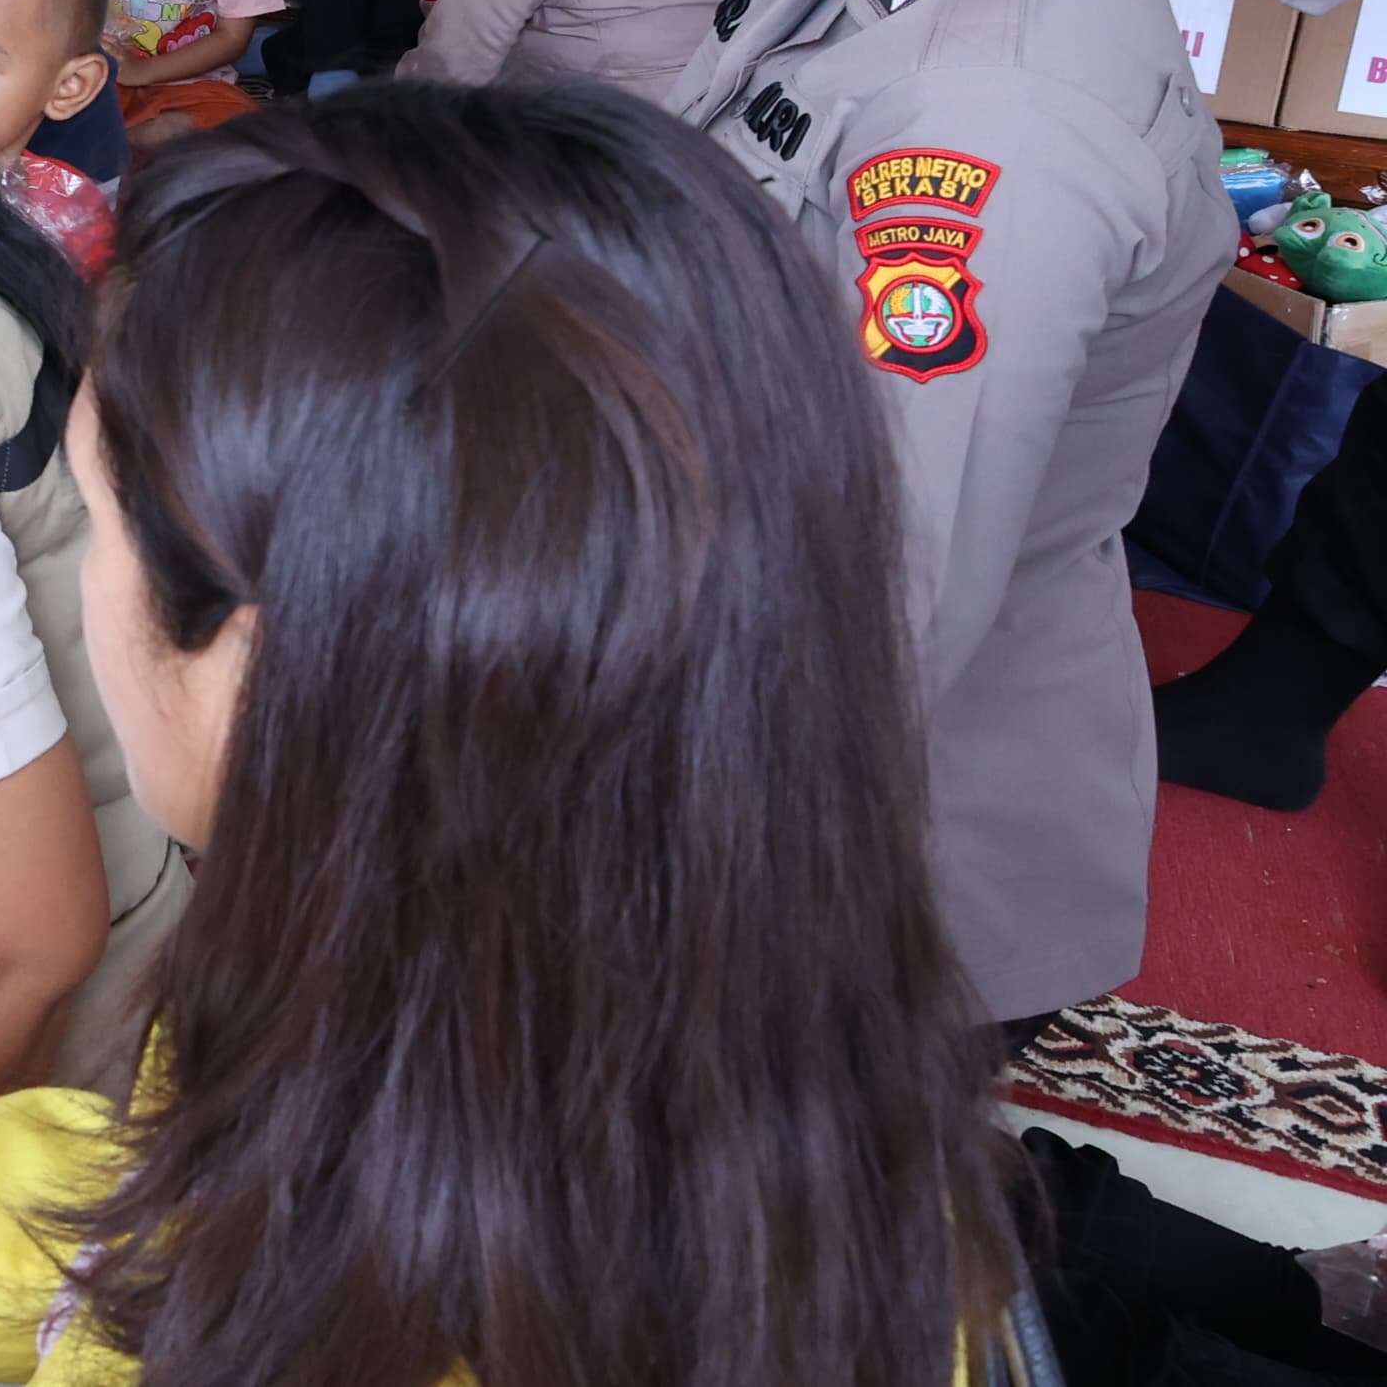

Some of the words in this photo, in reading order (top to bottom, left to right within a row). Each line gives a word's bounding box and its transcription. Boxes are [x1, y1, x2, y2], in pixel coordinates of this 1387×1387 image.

[853, 157, 913, 197] POLRES
[915, 156, 987, 188] METRO
[862, 177, 971, 208] BEKASI
[868, 225, 920, 247] METRO
[923, 226, 966, 248] JAYA
